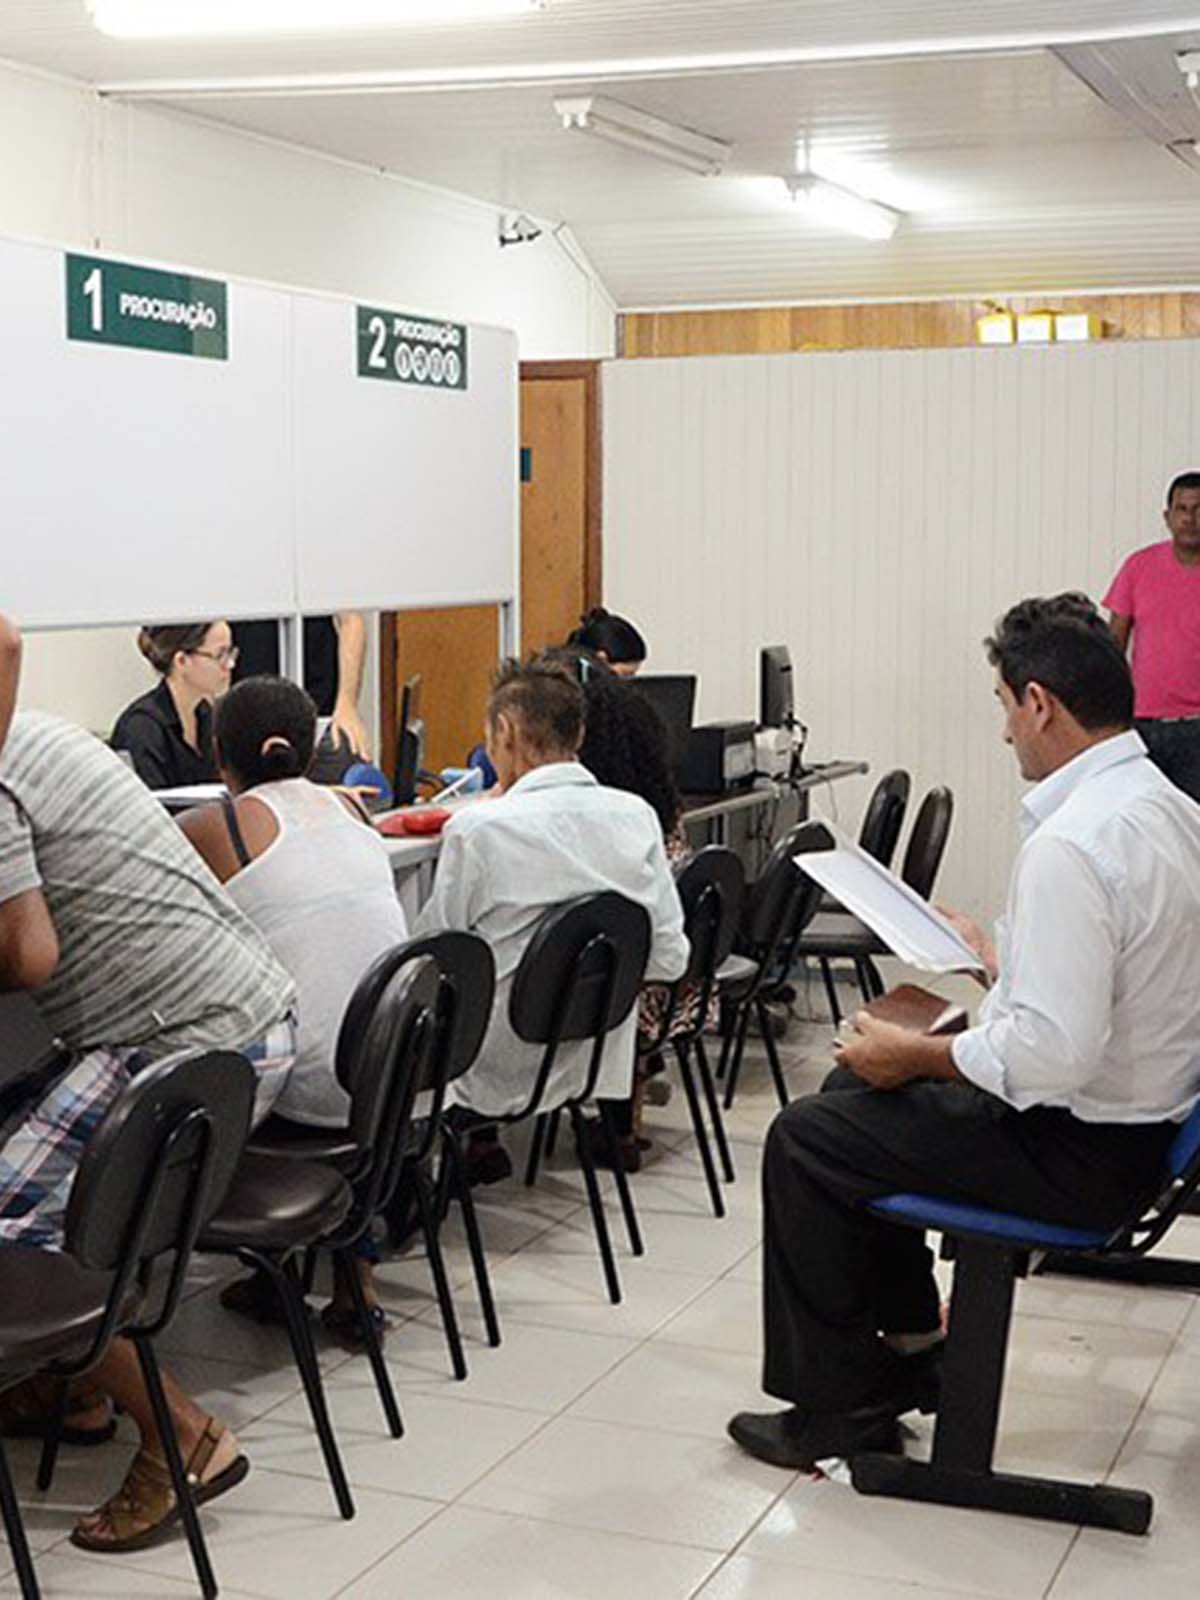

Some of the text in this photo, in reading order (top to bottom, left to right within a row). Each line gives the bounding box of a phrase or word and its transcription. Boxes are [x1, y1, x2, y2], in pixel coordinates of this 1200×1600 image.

[83, 268, 217, 332] 1 PROCURAÇÃO
[368, 316, 387, 368] 2
